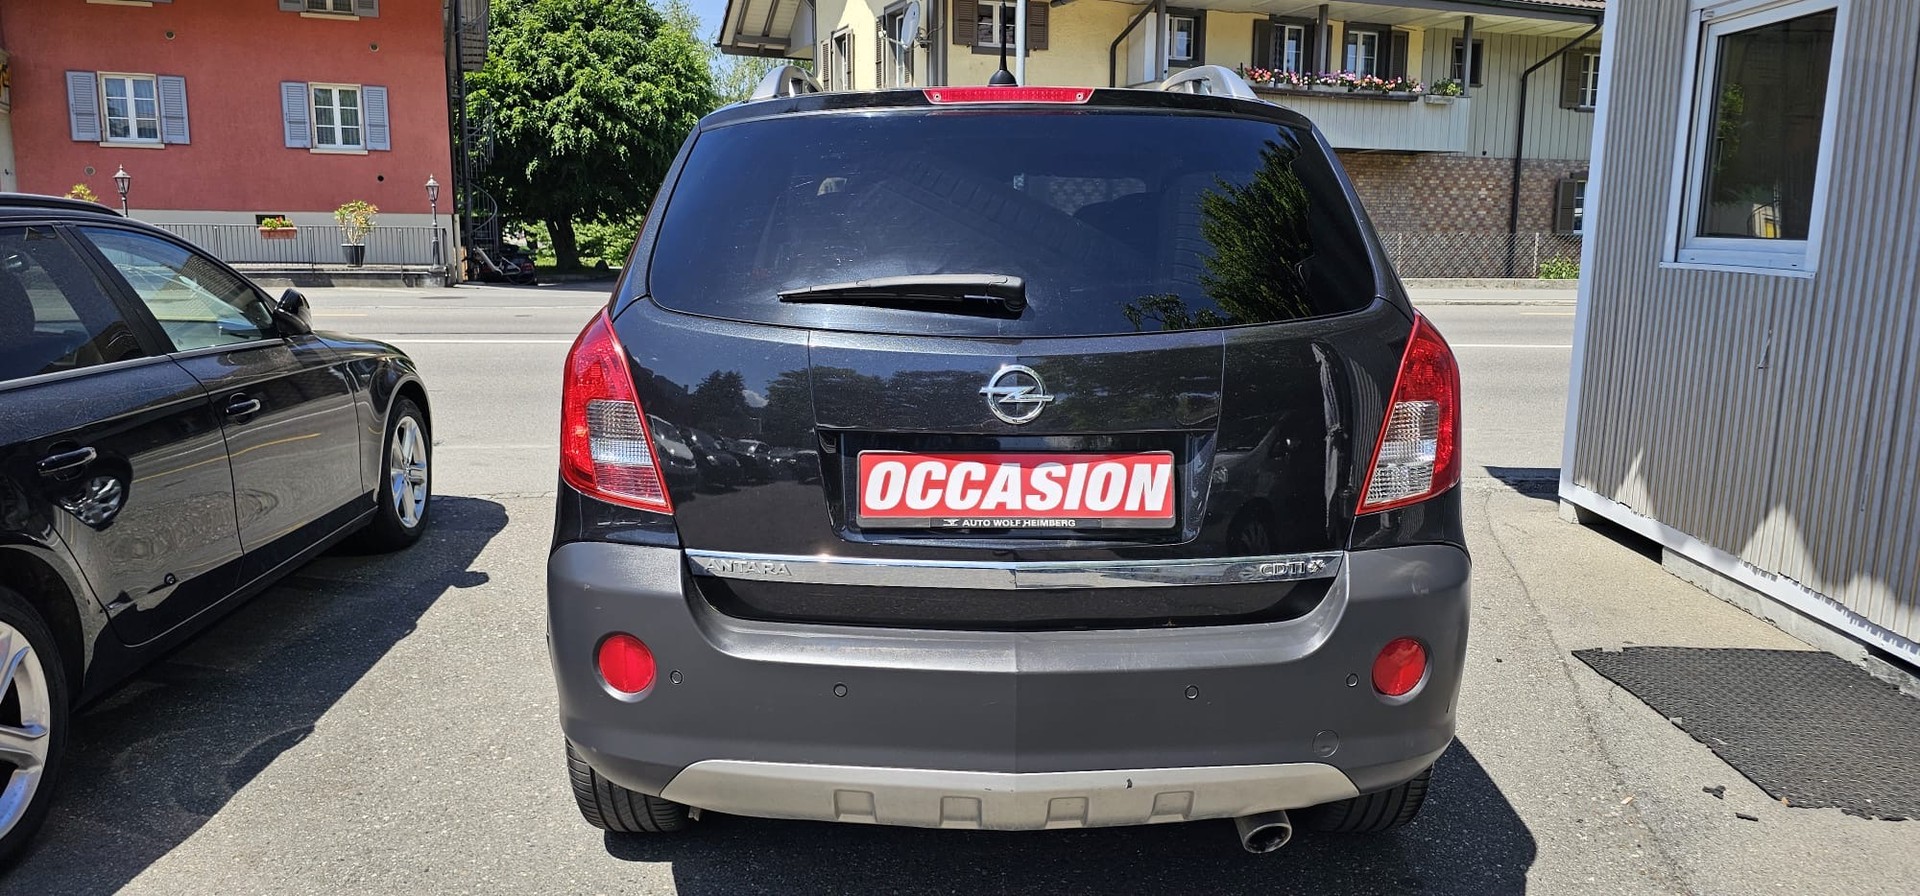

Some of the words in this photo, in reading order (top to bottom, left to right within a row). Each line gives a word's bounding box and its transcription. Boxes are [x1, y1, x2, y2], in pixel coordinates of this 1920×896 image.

[865, 461, 1171, 511] OCCASION
[962, 519, 991, 527] AUTO
[706, 558, 792, 576] ANTARA
[1260, 561, 1306, 576] CDTI
